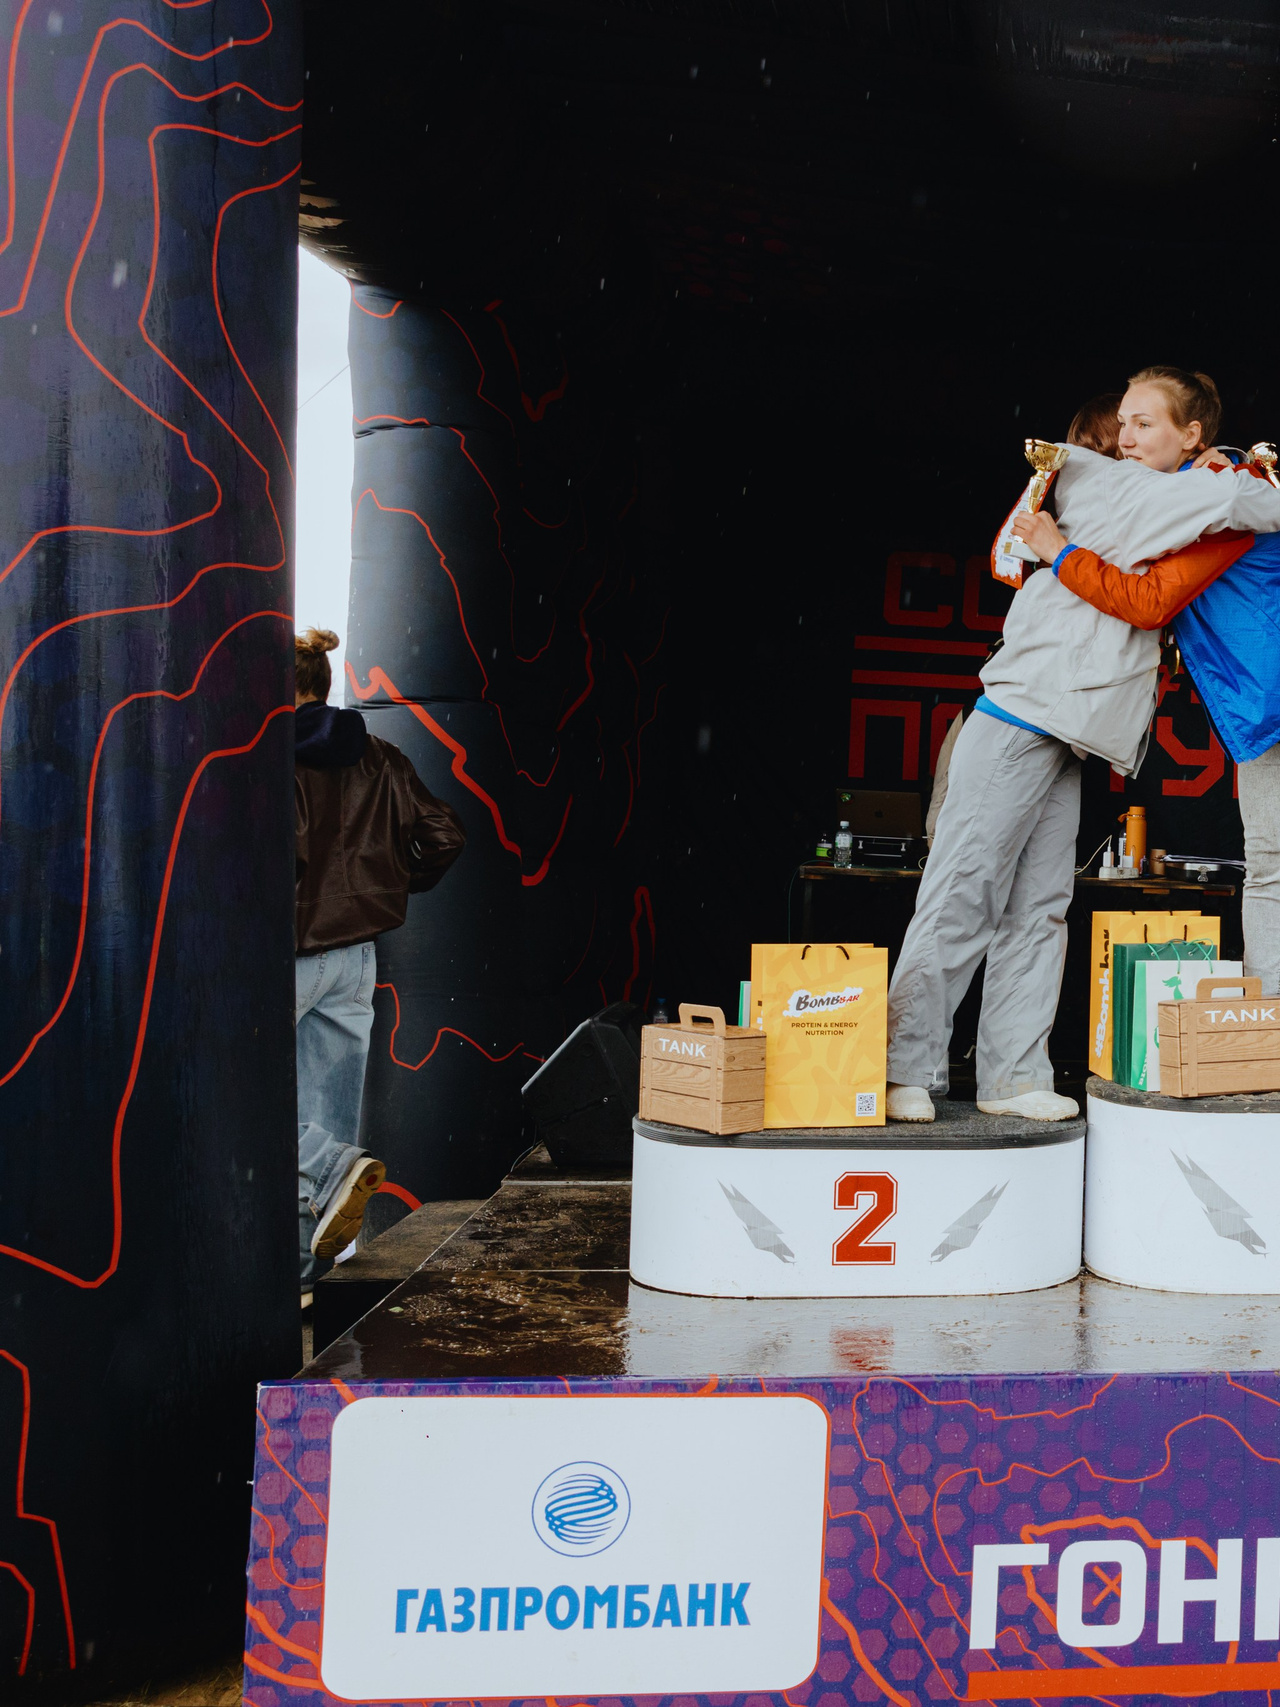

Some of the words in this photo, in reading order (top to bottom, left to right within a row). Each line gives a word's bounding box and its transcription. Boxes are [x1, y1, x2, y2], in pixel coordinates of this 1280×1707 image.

[1204, 1008, 1277, 1024] TANK
[659, 1038, 707, 1058] TANK
[832, 1171, 898, 1266] 2
[394, 1582, 752, 1633] ГАЗПРОМБАНК
